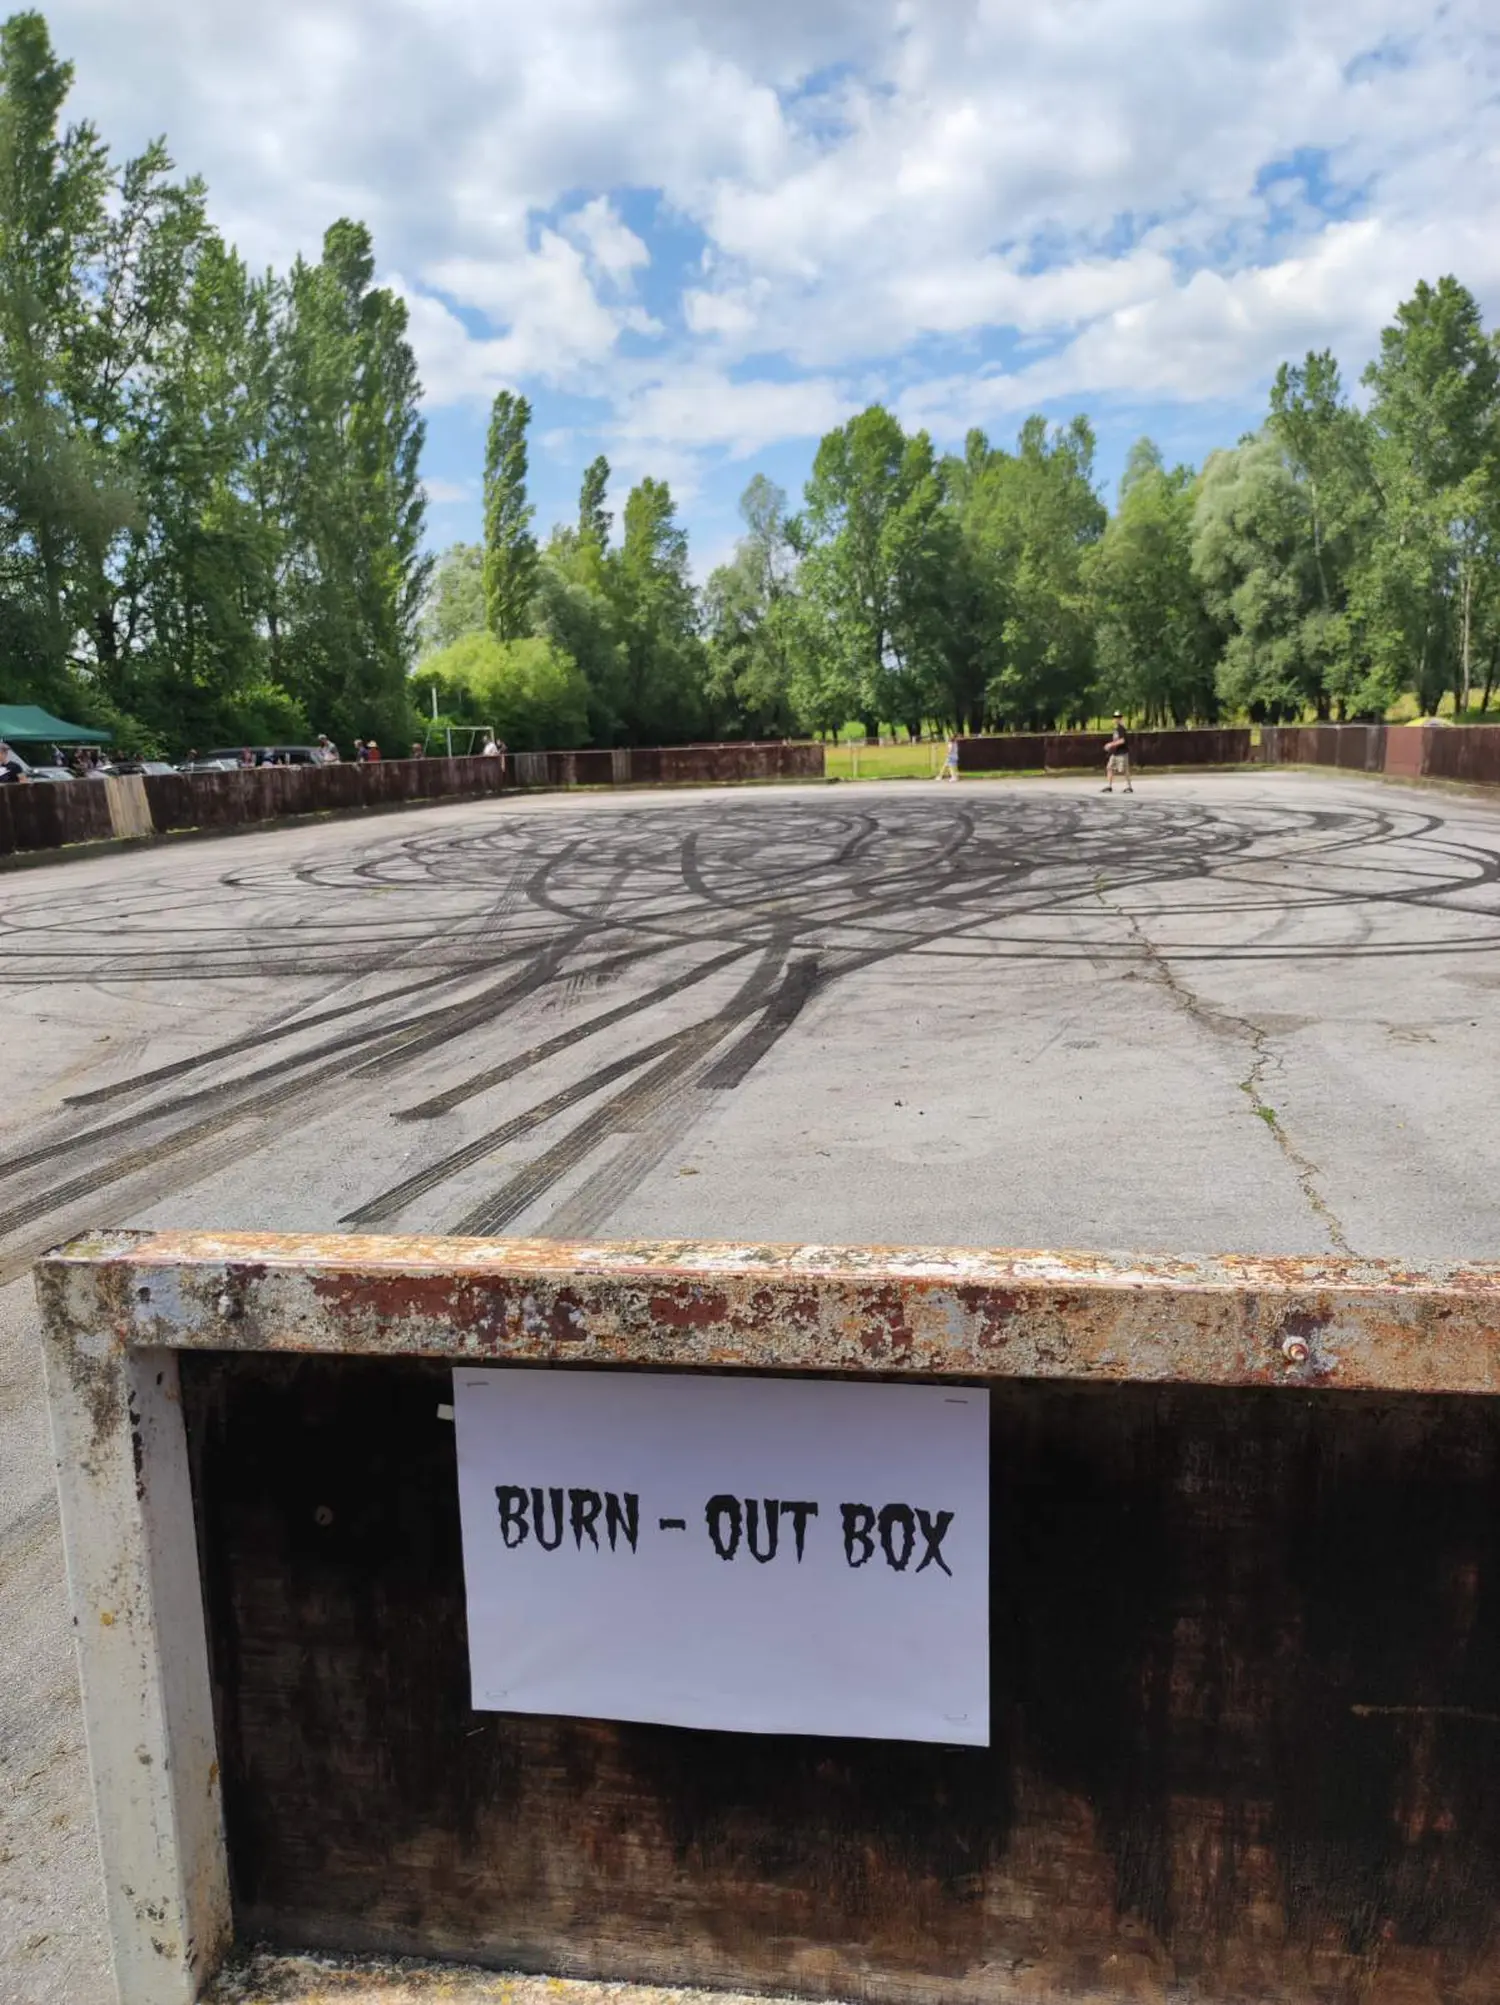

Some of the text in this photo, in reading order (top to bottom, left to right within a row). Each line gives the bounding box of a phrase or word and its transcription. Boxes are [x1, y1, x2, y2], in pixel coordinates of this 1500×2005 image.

[495, 1485, 640, 1554] BURN
[705, 1494, 819, 1563] OUT
[839, 1502, 955, 1577] BOX
